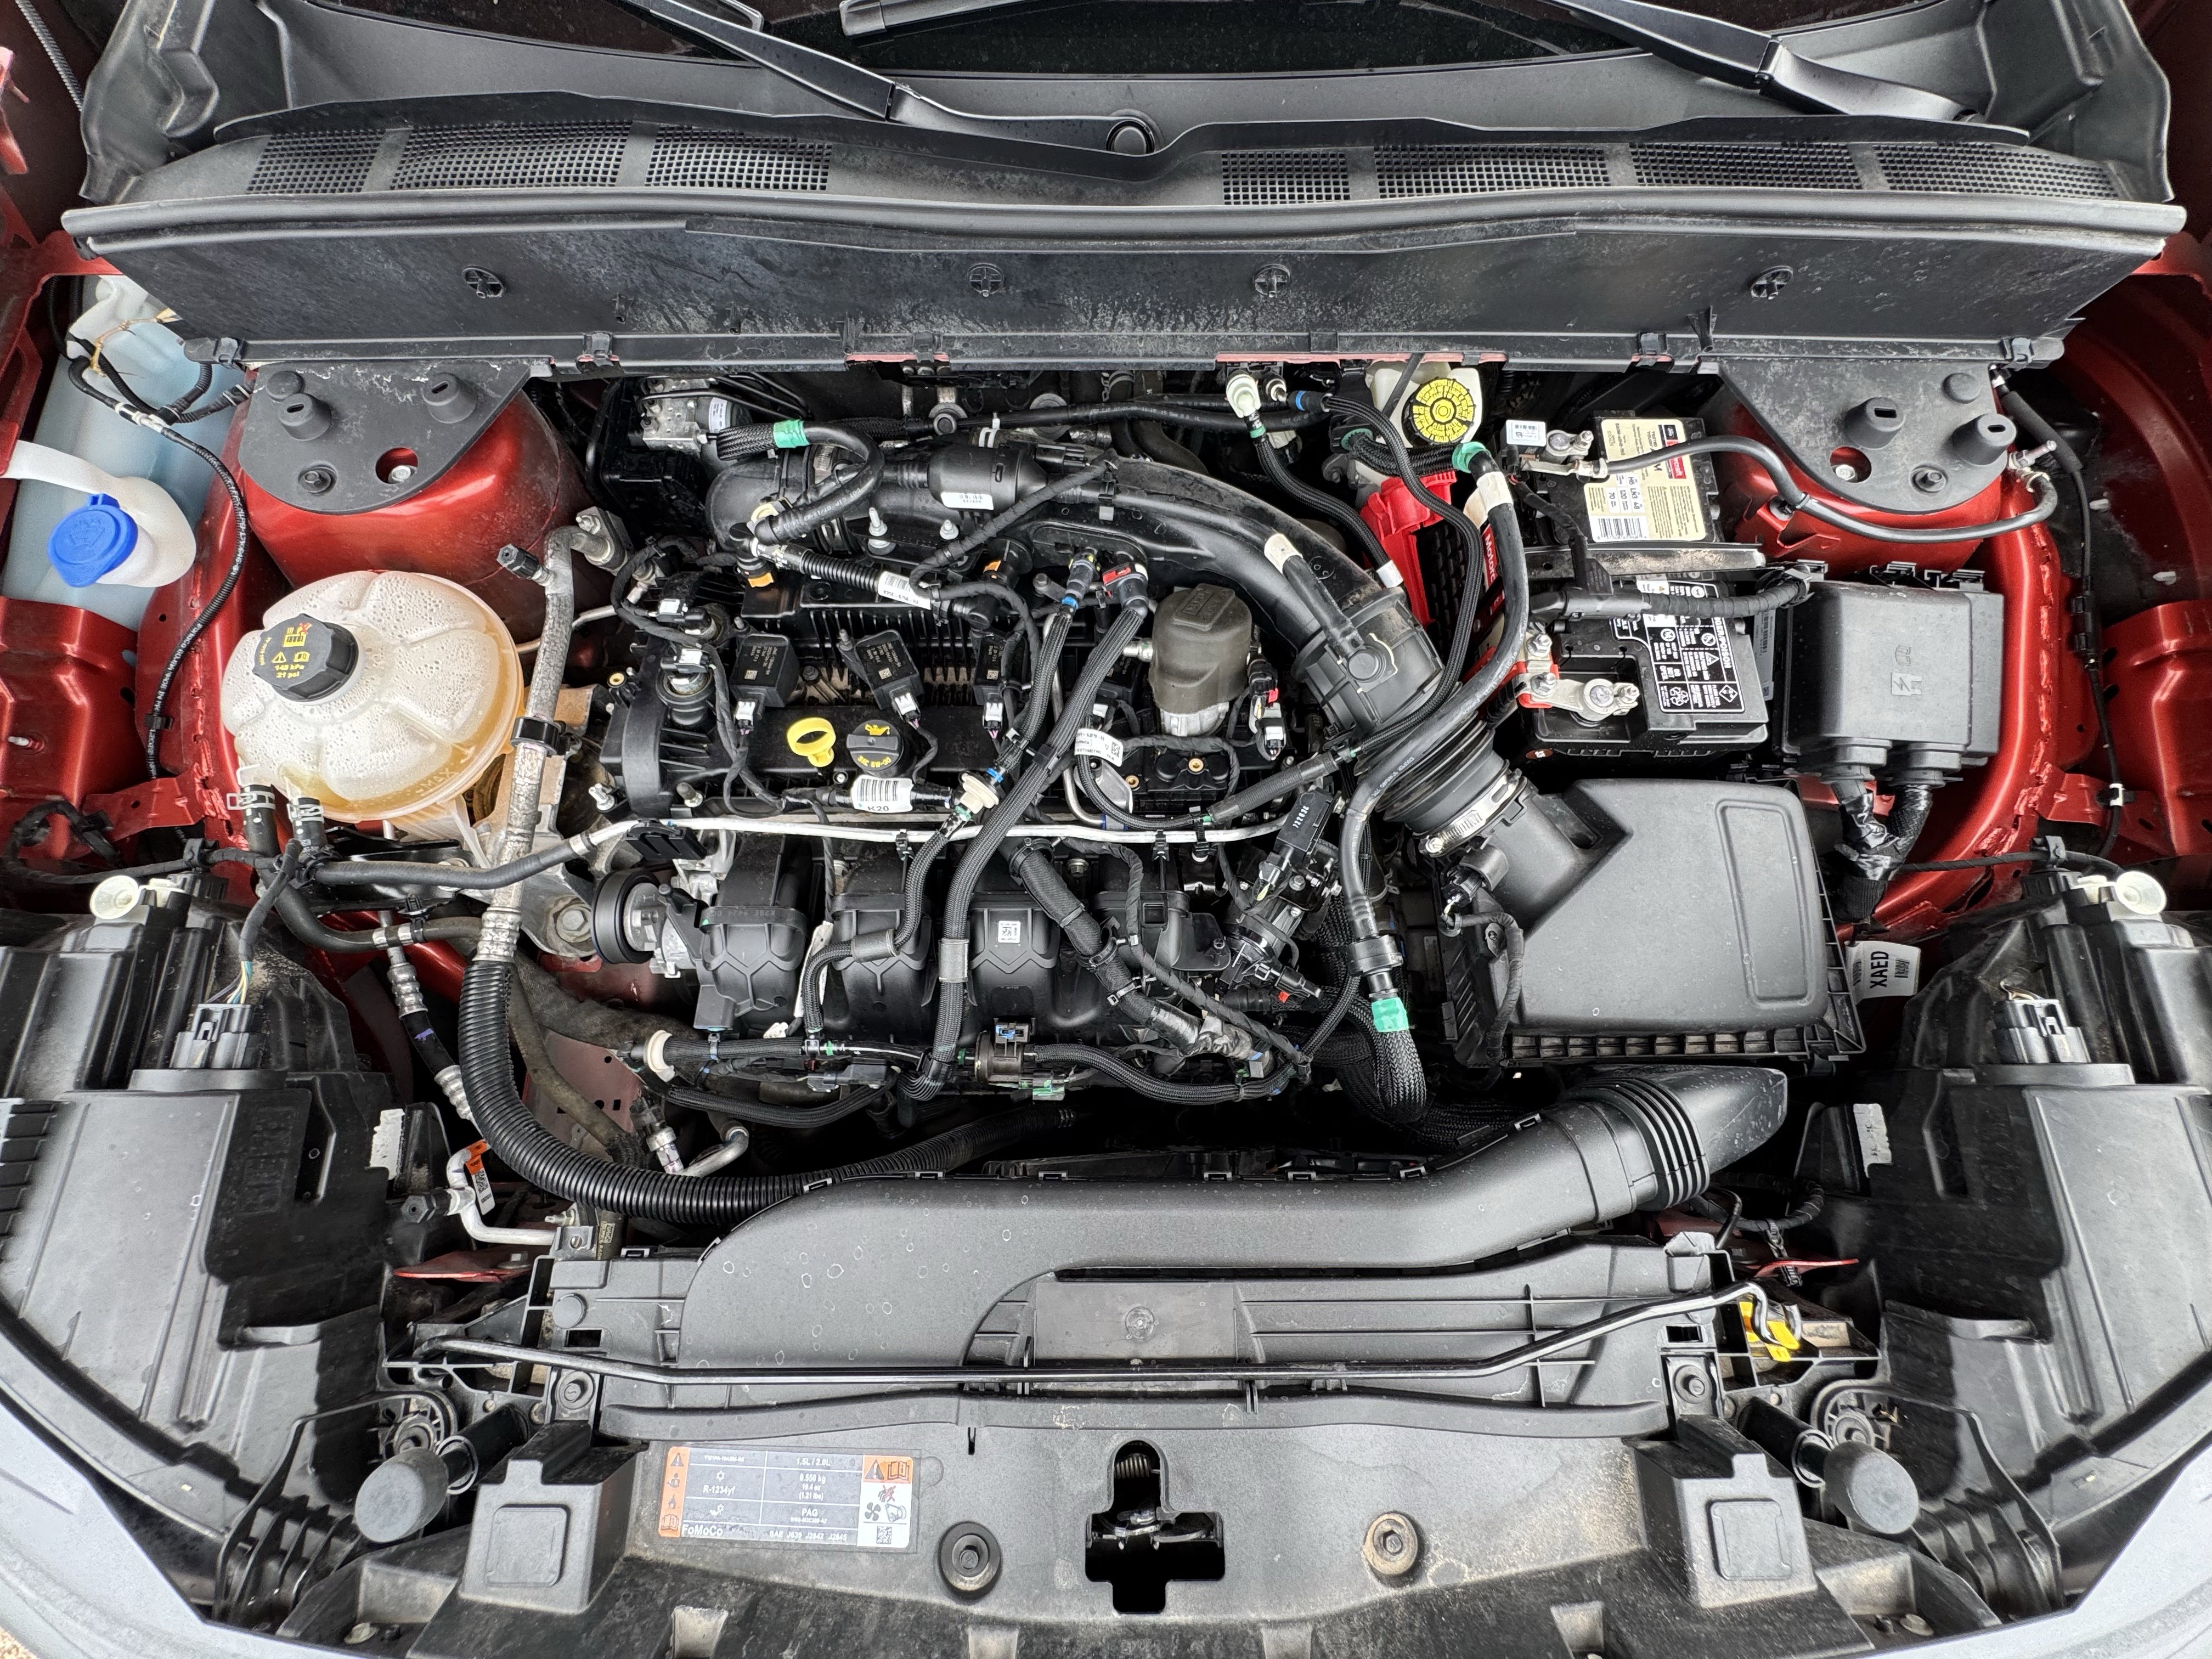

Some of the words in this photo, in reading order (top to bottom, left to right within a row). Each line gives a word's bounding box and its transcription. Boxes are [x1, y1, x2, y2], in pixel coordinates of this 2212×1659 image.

[1485, 533, 1497, 583] Motorc
[1869, 951, 1889, 989] XAED
[796, 1457, 811, 1466] 1.5L
[815, 1458, 831, 1466] 2.0L
[799, 1474, 817, 1482] 0.550
[818, 1474, 826, 1484] kg
[703, 1485, 736, 1495] R-1234yf
[801, 1508, 819, 1517] PAG
[681, 1524, 724, 1537] FoMoCo
[769, 1530, 783, 1538] SAE
